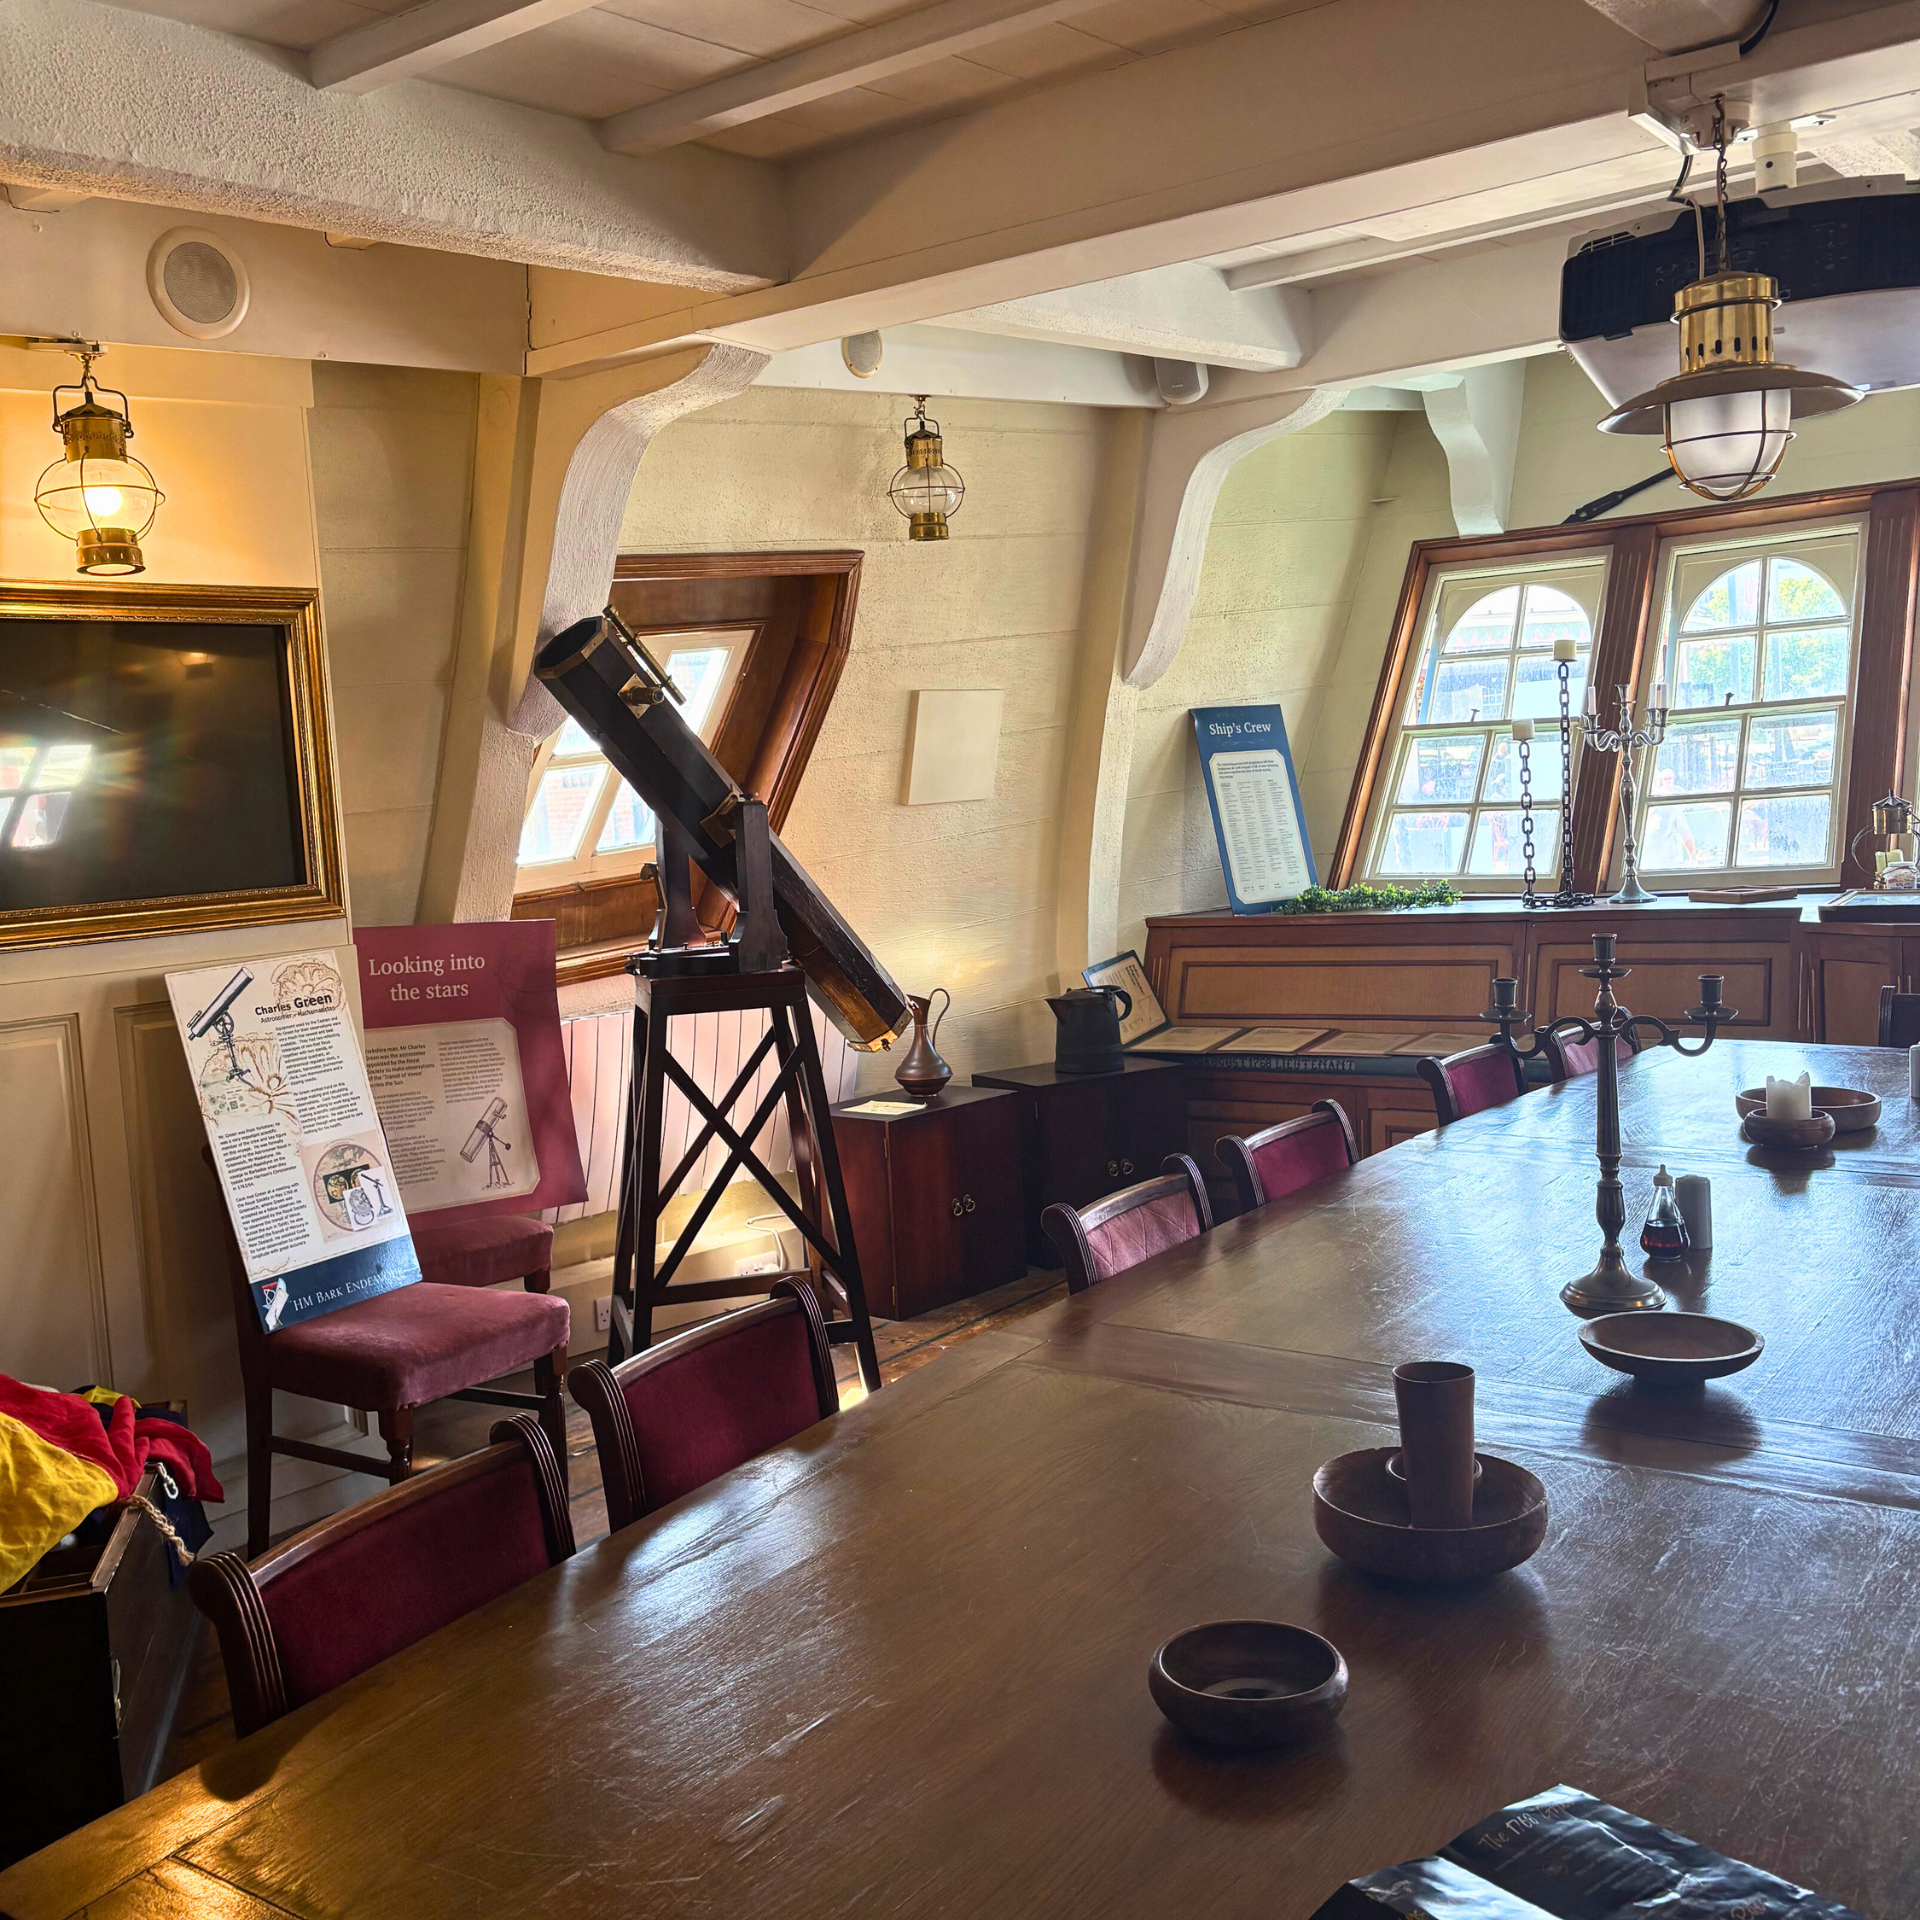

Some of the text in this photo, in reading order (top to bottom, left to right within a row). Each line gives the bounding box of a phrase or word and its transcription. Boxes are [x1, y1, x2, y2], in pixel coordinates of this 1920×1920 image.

[1209, 721, 1271, 738] Ship's Crew
[368, 953, 485, 976] Looking into
[390, 983, 469, 1001] the stars
[254, 994, 332, 1016] Charles Green
[259, 1014, 292, 1023] Astronomer
[293, 1294, 313, 1311] HM
[315, 1286, 343, 1303] BARK
[1478, 1812, 1539, 1851] The 1768
